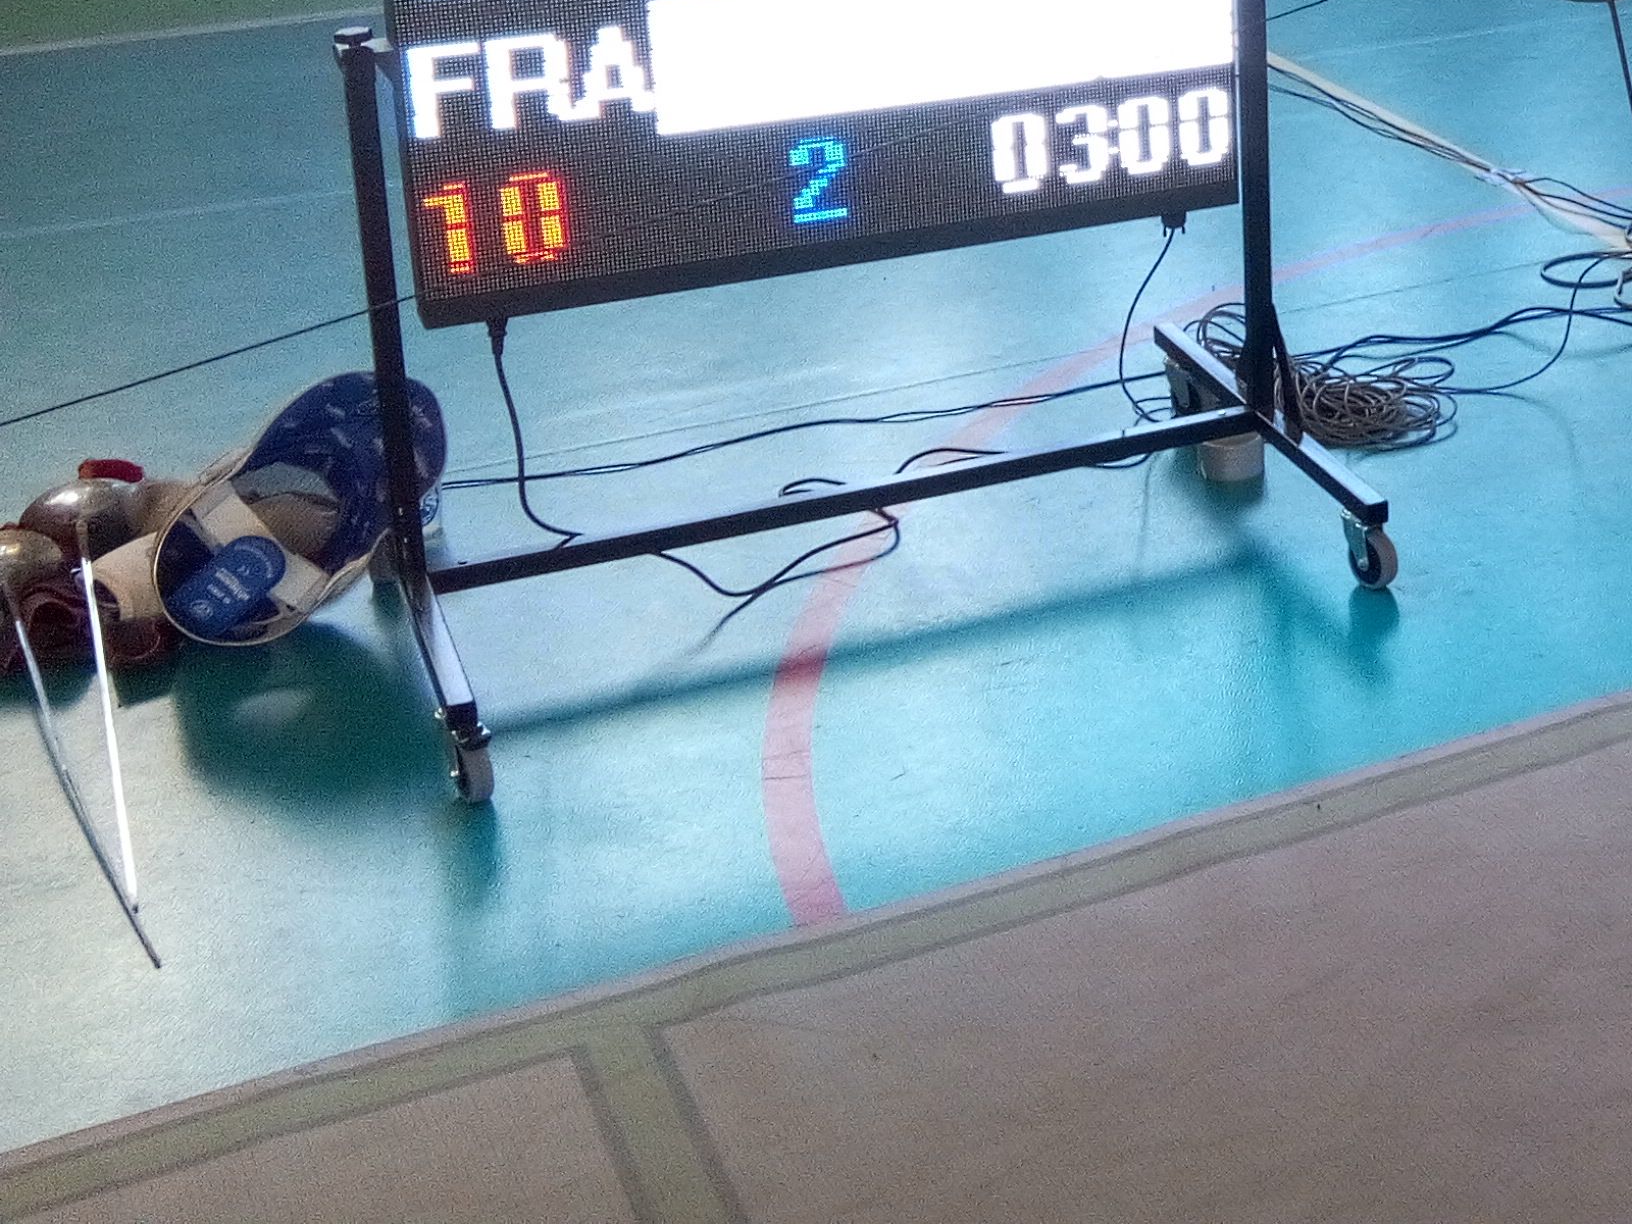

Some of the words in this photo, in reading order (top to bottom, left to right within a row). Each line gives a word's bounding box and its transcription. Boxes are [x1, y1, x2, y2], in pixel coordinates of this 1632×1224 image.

[405, 25, 655, 140] FRA
[422, 169, 570, 275] 10
[786, 133, 850, 228] 2
